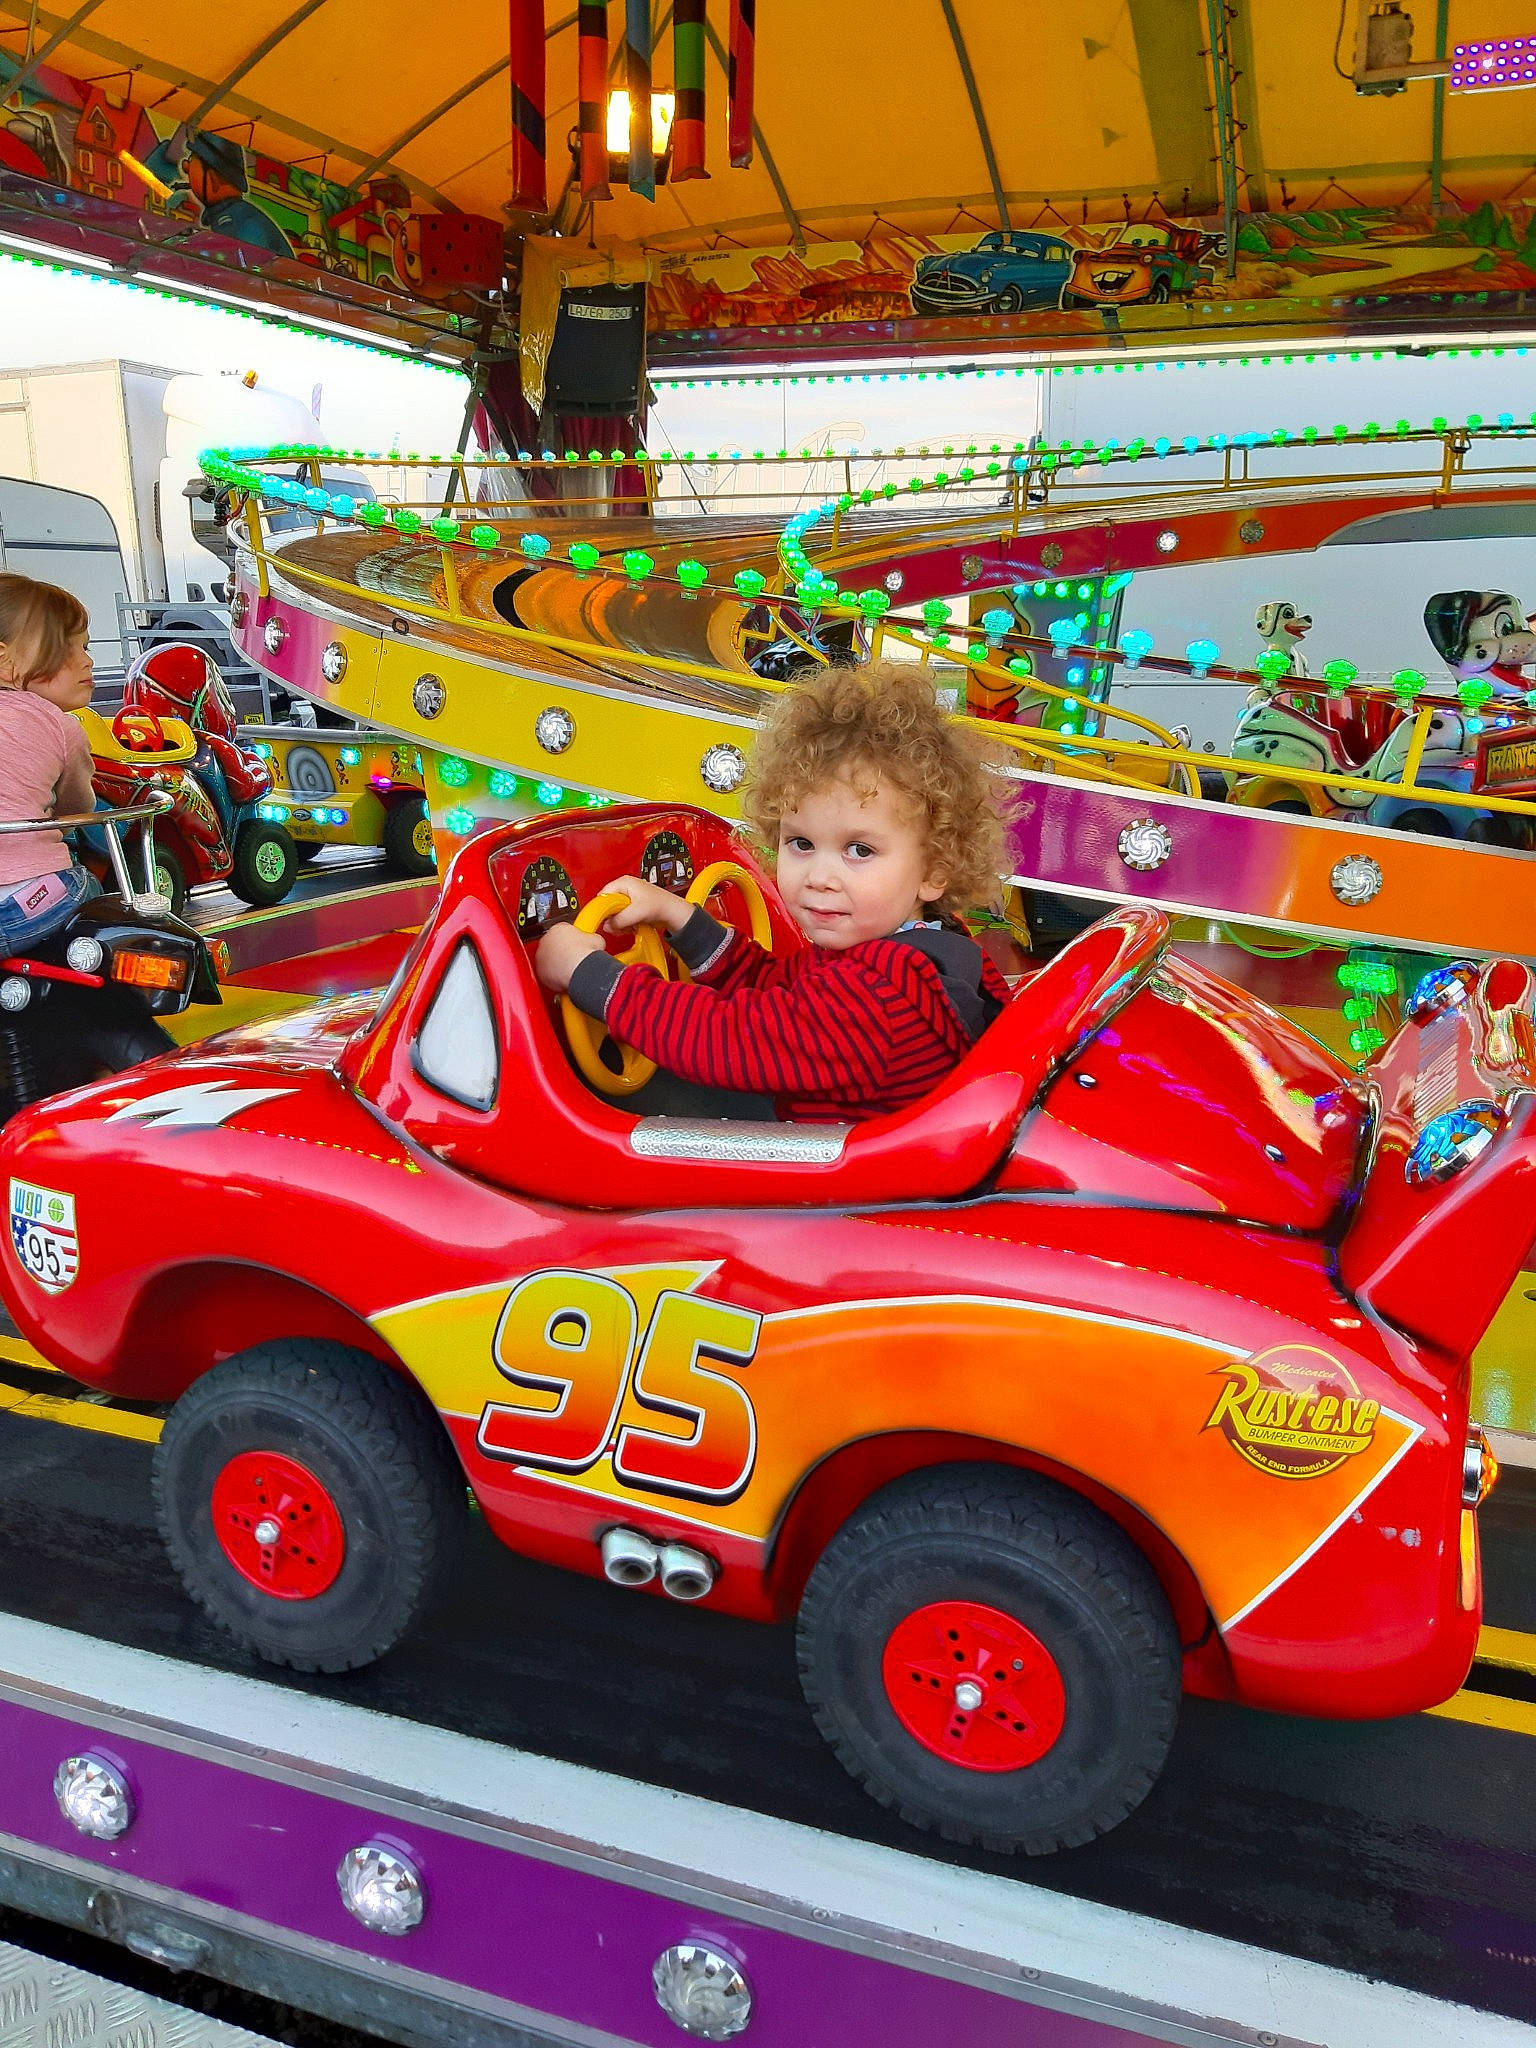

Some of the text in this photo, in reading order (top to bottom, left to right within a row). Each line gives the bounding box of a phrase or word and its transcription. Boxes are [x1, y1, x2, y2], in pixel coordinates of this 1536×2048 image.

[608, 308, 629, 319] 250
[28, 1233, 61, 1281] 95
[1270, 1362, 1337, 1379] Medicated
[475, 1266, 764, 1507] 95
[1248, 1427, 1357, 1450] BUMPER OINTMENT
[1245, 1445, 1331, 1474] REAR END FORMULA
